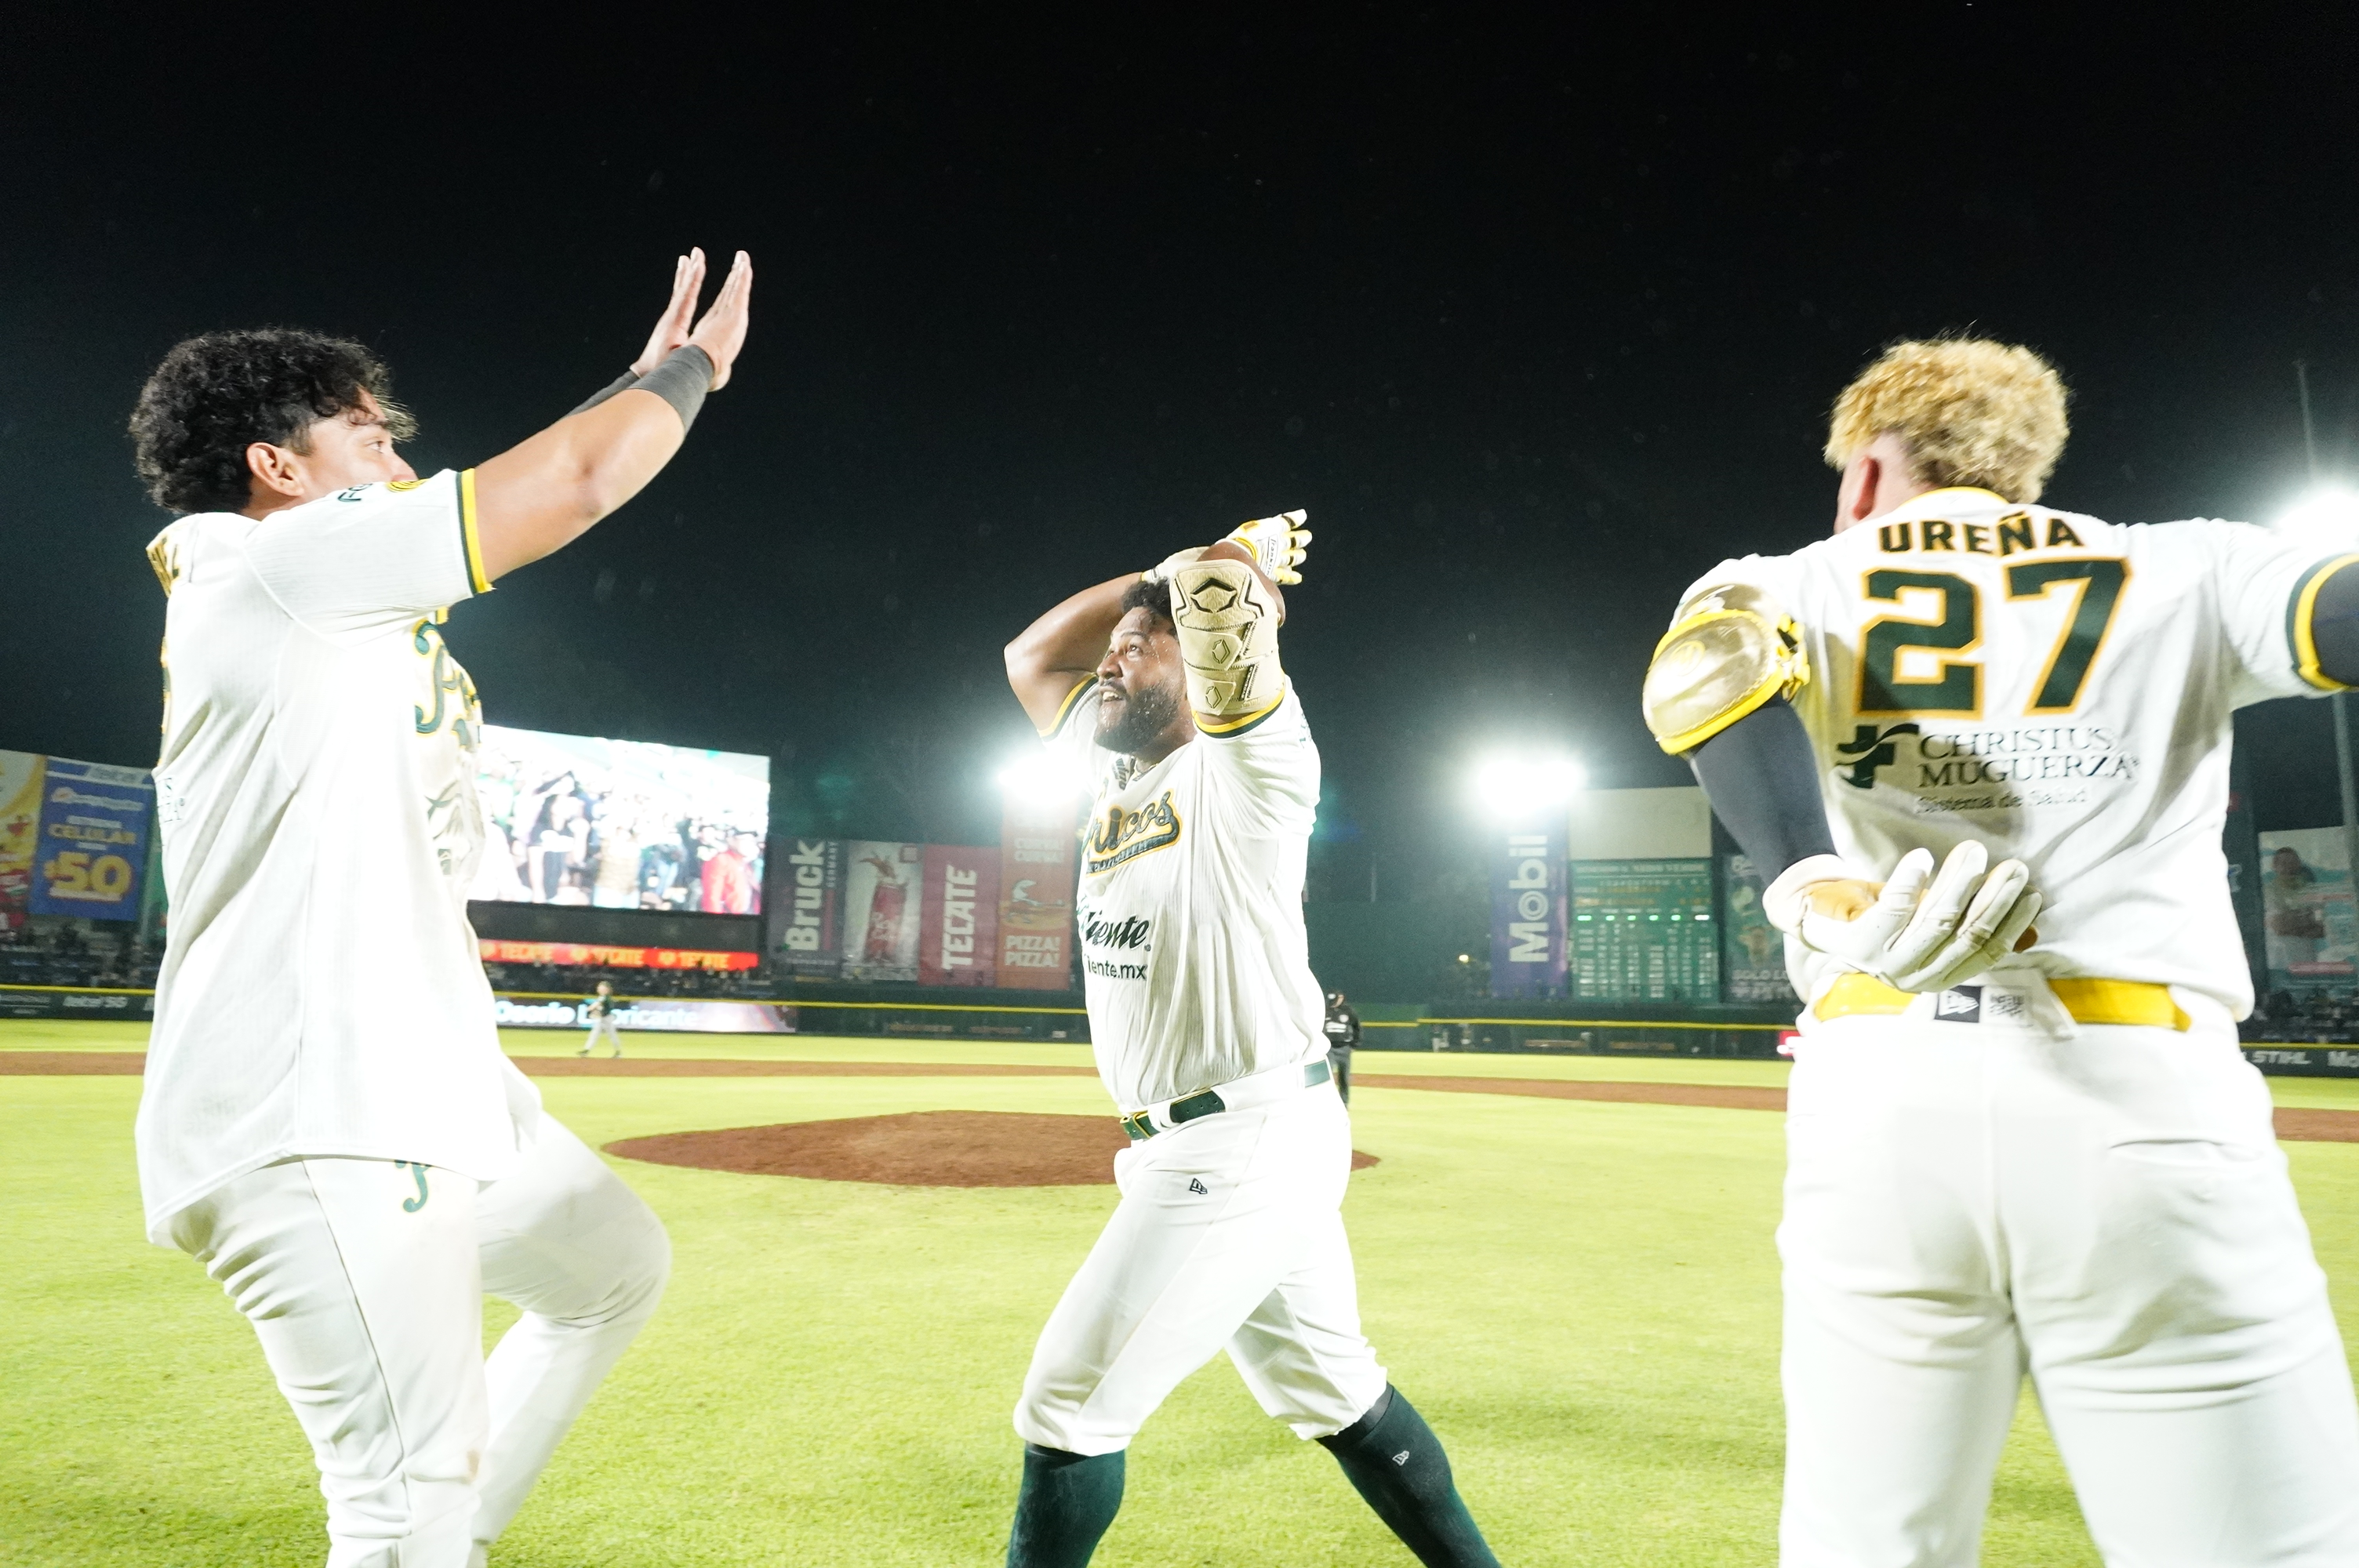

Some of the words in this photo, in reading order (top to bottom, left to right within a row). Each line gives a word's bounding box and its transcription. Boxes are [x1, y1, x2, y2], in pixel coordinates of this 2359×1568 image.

[1878, 510, 2085, 557] UREÑA
[1853, 555, 2133, 720] 27
[1920, 728, 2114, 760] CHRISTUS
[785, 839, 824, 951] Bruck
[1509, 835, 1548, 962] Mobil
[941, 865, 978, 970] TECATE
[1005, 935, 1060, 950] PIZZA!
[1004, 951, 1060, 967] PIZZA!
[1087, 954, 1148, 981] iente.mx
[576, 1003, 699, 1027] Lricante
[2252, 1051, 2312, 1065] STIHL
